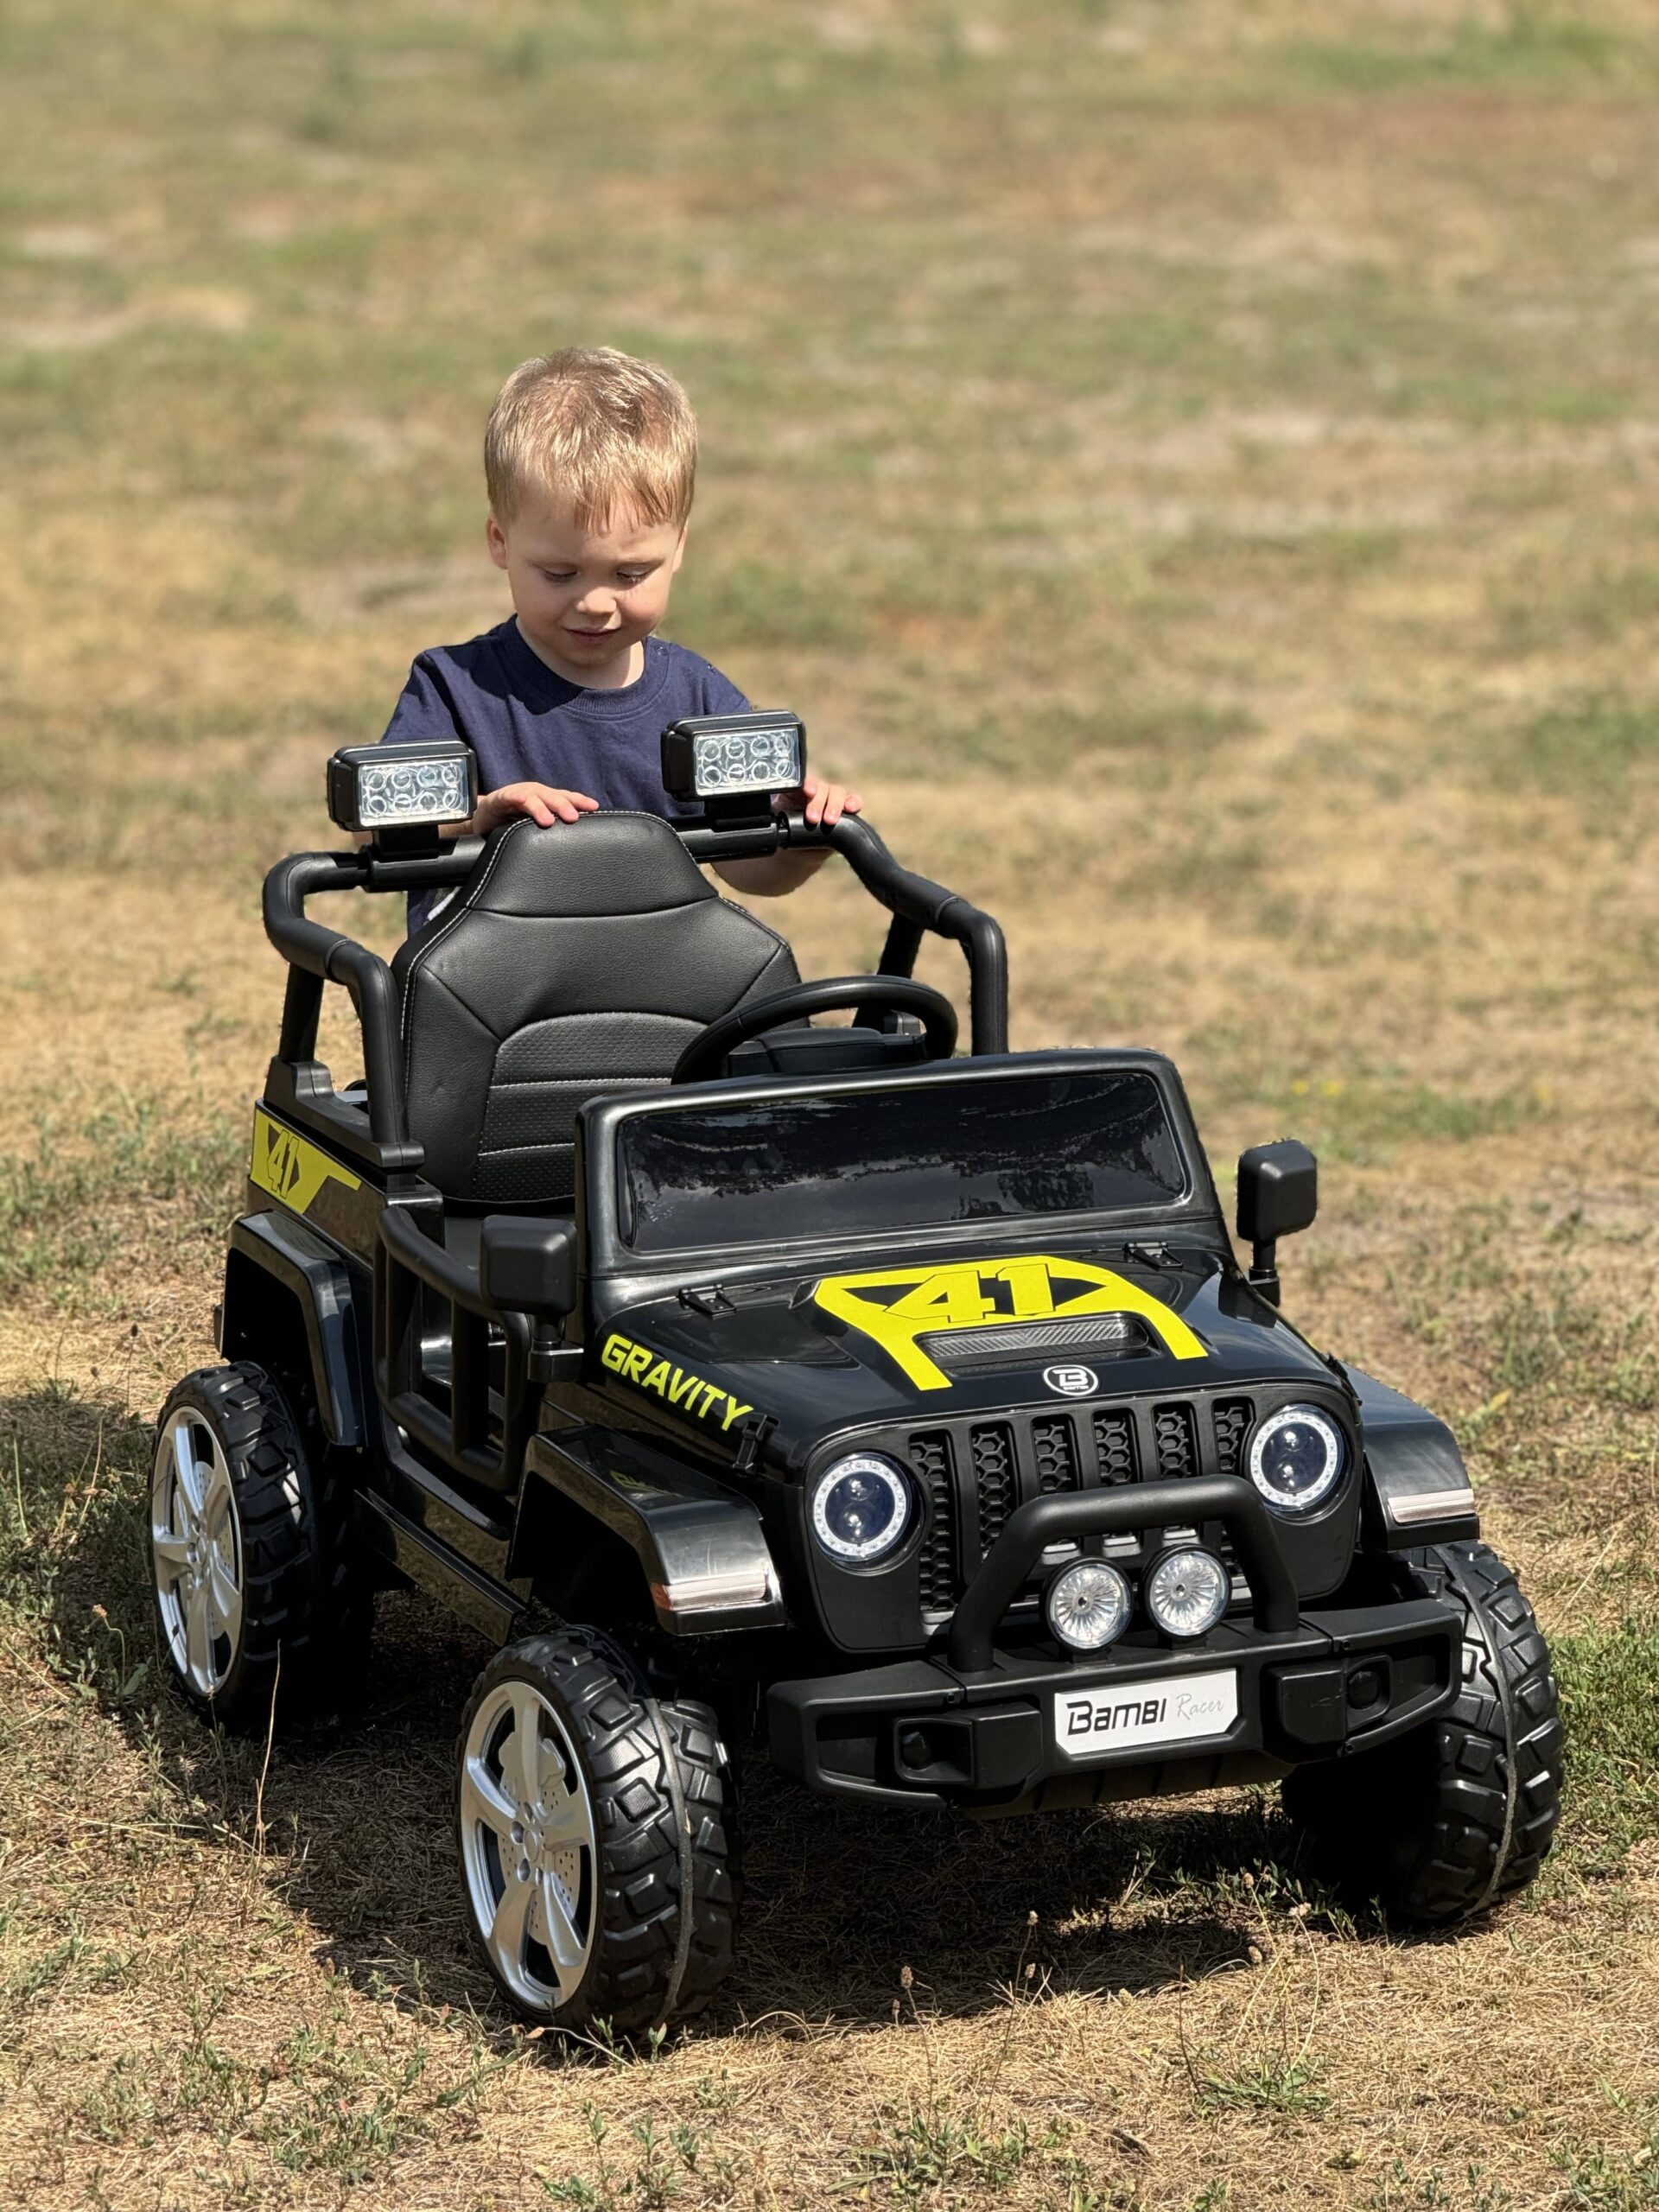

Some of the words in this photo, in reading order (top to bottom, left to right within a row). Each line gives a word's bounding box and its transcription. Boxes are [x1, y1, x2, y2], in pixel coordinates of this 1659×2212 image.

[268, 1128, 300, 1200] 41
[883, 1262, 1054, 1323] 41
[601, 1333, 753, 1431] GRAVITY
[1175, 1693, 1224, 1721] Racer
